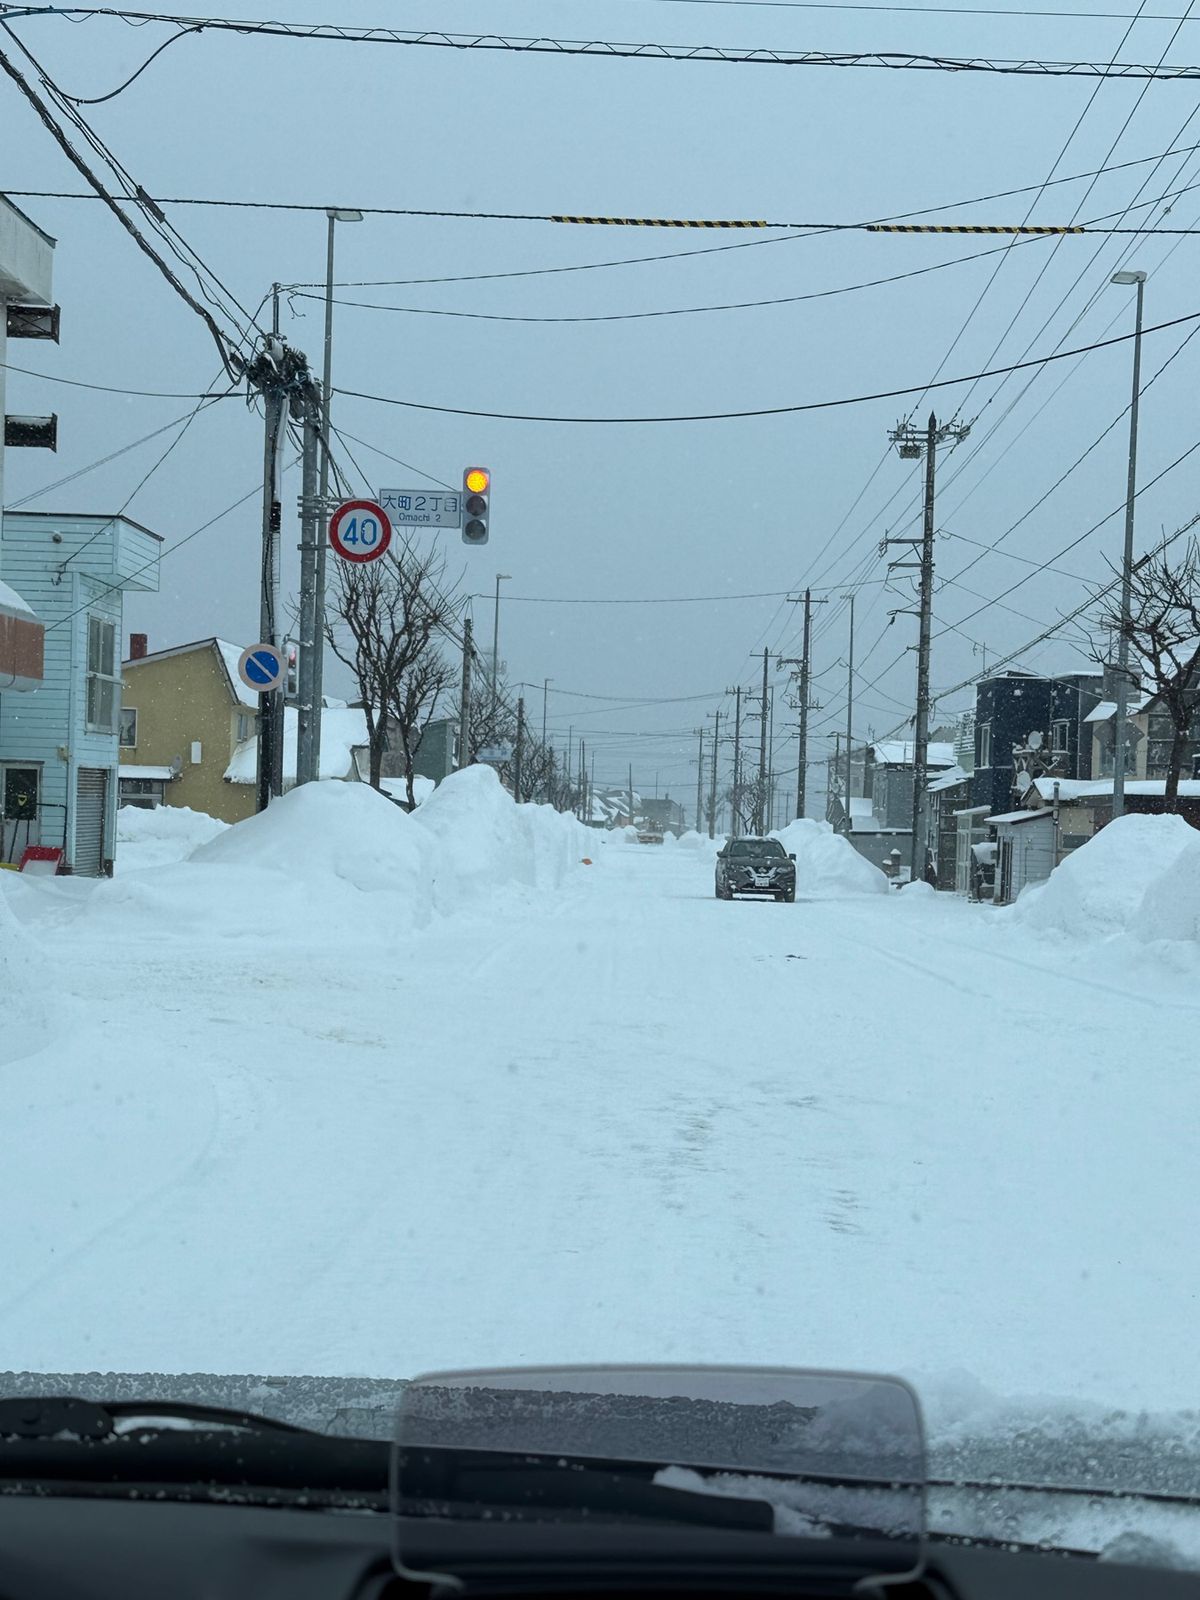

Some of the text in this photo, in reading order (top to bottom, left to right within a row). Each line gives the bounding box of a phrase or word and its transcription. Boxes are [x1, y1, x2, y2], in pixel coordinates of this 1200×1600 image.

[399, 512, 441, 523] Omachi 2
[343, 518, 377, 545] 40
